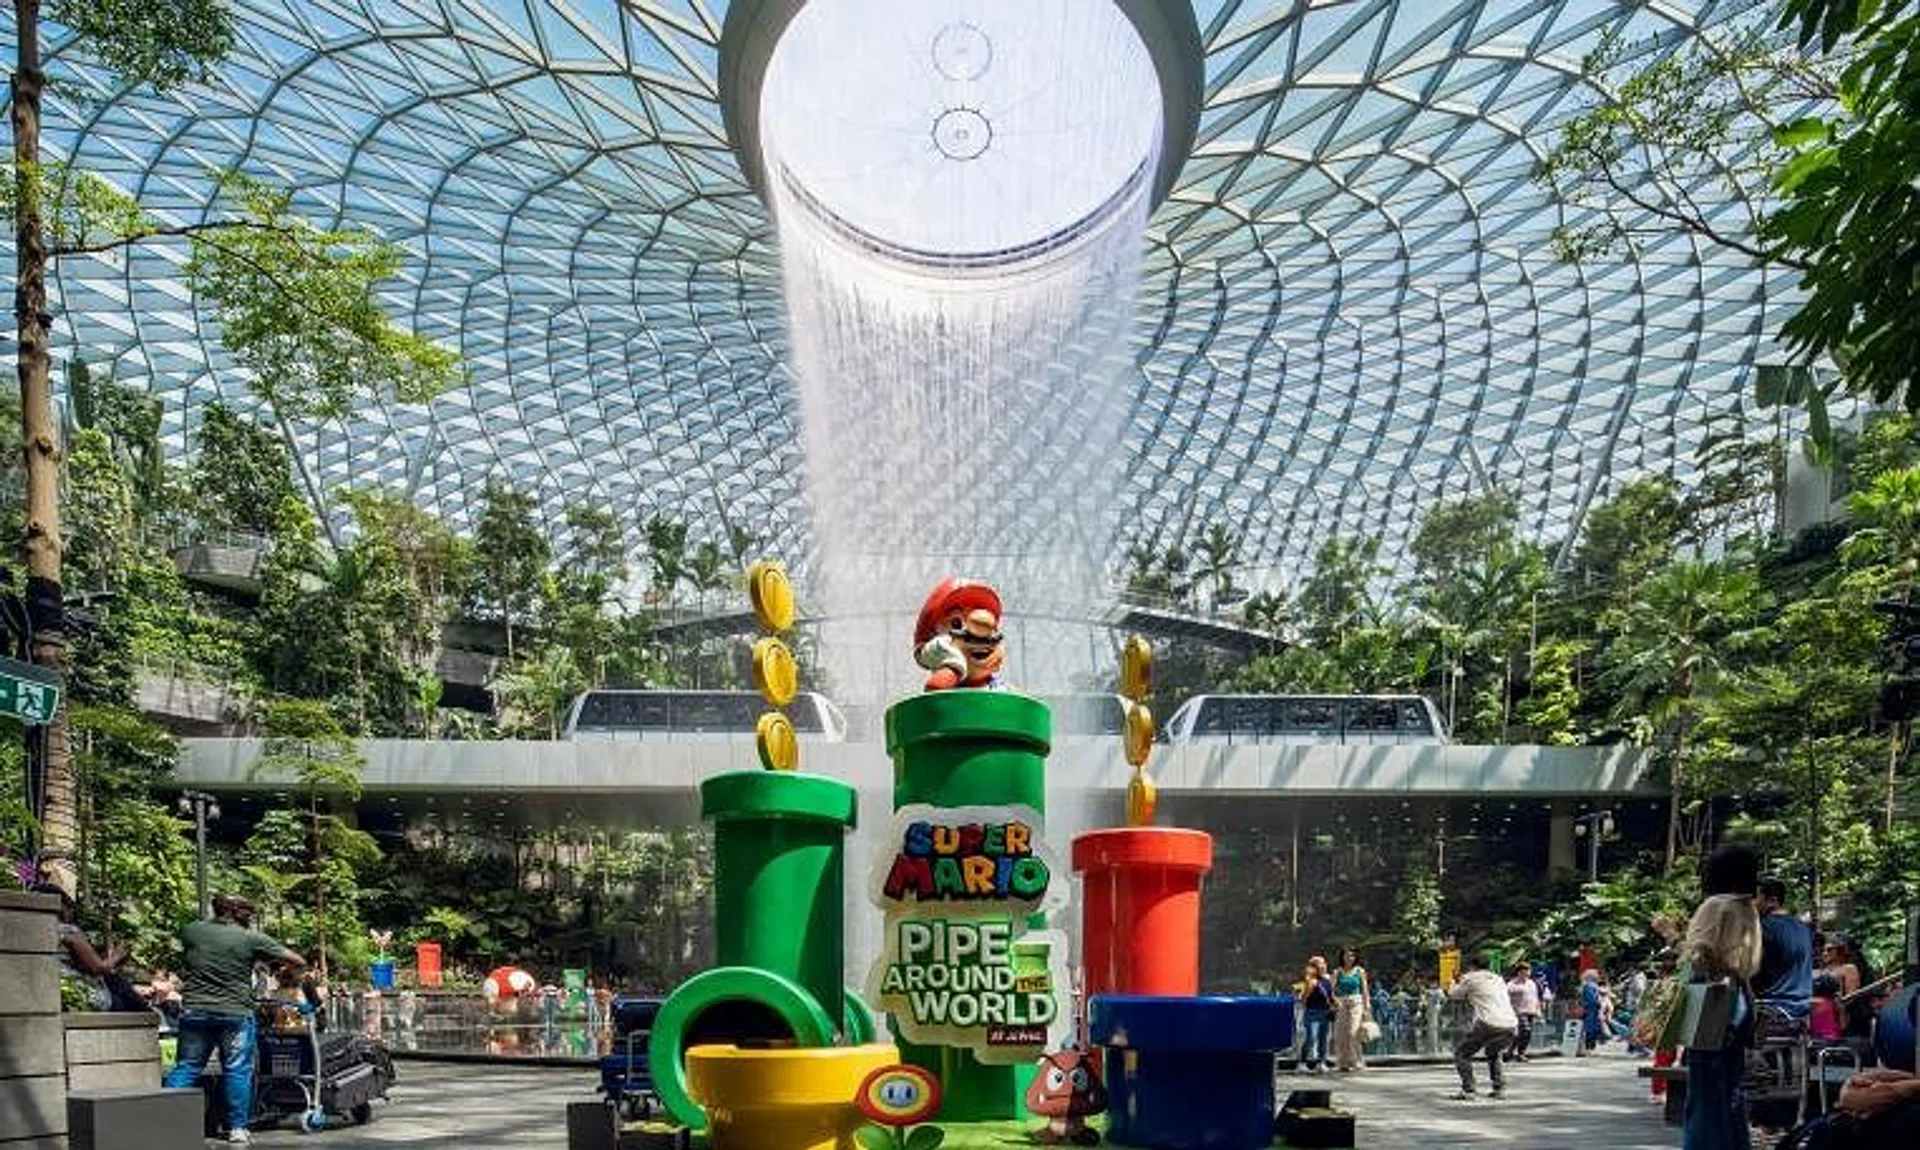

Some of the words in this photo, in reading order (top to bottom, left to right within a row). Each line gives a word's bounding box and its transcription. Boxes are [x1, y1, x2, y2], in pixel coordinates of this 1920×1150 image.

[904, 820, 1032, 856] SUPER
[884, 855, 1050, 899] MARIO
[900, 921, 1012, 965] PIPE
[883, 965, 1015, 993] AROUND
[911, 993, 1058, 1025] WORLD
